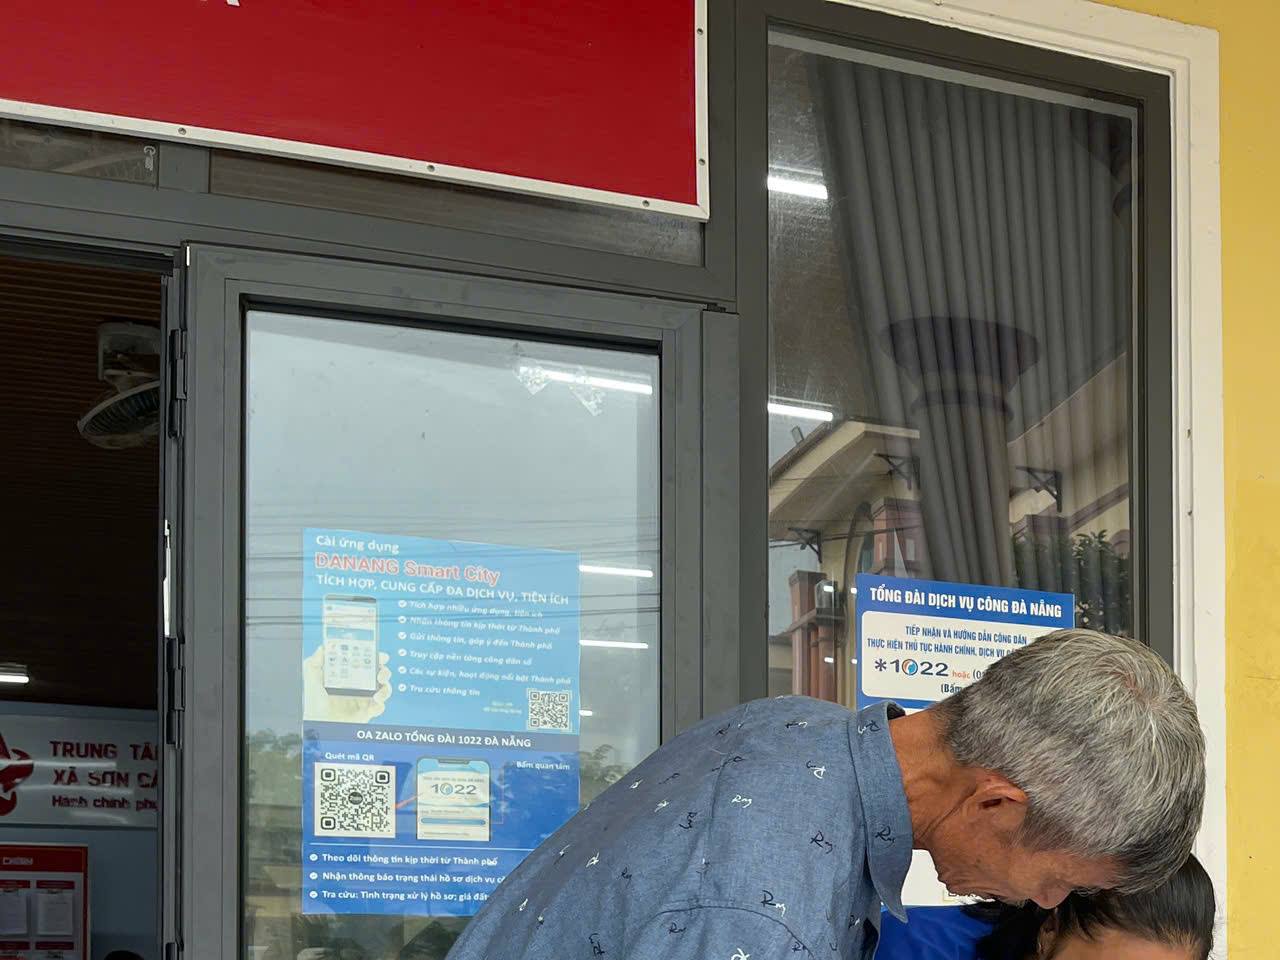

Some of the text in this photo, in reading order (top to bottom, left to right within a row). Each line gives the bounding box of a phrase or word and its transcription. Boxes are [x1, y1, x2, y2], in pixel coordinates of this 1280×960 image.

[316, 535, 400, 555] Cài ứng dụng
[403, 560, 460, 580] Smart
[463, 565, 501, 587] City
[316, 573, 344, 585] TÍCH
[348, 578, 377, 590] HỢP,
[381, 580, 416, 592] CUNG
[420, 582, 443, 594] CẤP
[466, 587, 495, 599] DỊCH
[870, 584, 1062, 617] TỔNG ĐÀI DỊCH VỤ CÔNG ĐÀ NẴNG
[905, 624, 920, 636] TIẾP
[922, 626, 941, 639] NHẬN
[942, 627, 952, 638] VÀ
[953, 629, 977, 641] HƯỚNG
[993, 632, 1012, 643] CÔNG
[1013, 634, 1027, 645] DÂN
[867, 638, 885, 650] THỰC
[886, 639, 903, 651] HIỆN
[919, 642, 933, 654] TỤC
[934, 642, 953, 654] HÀNH
[978, 647, 994, 658] DỊCH
[357, 730, 531, 747] OA ZALO TỔNG ĐÀI 1022 ĐÀ NẴNG
[50, 741, 159, 760] TRUNG TÂ
[53, 766, 79, 785] XÃ
[88, 770, 129, 787] SƠN
[322, 853, 344, 862] Theo
[347, 854, 361, 862] dõi
[363, 855, 389, 864] thông
[405, 856, 418, 865] kịp
[453, 857, 479, 865] Thành
[322, 872, 347, 881] Nhận
[349, 872, 375, 882] thông
[377, 873, 393, 881] báo
[420, 874, 437, 882] thái
[465, 876, 483, 884] dịch
[360, 891, 380, 899] Tình
[430, 891, 441, 900] hồ
[458, 892, 471, 901] giá
